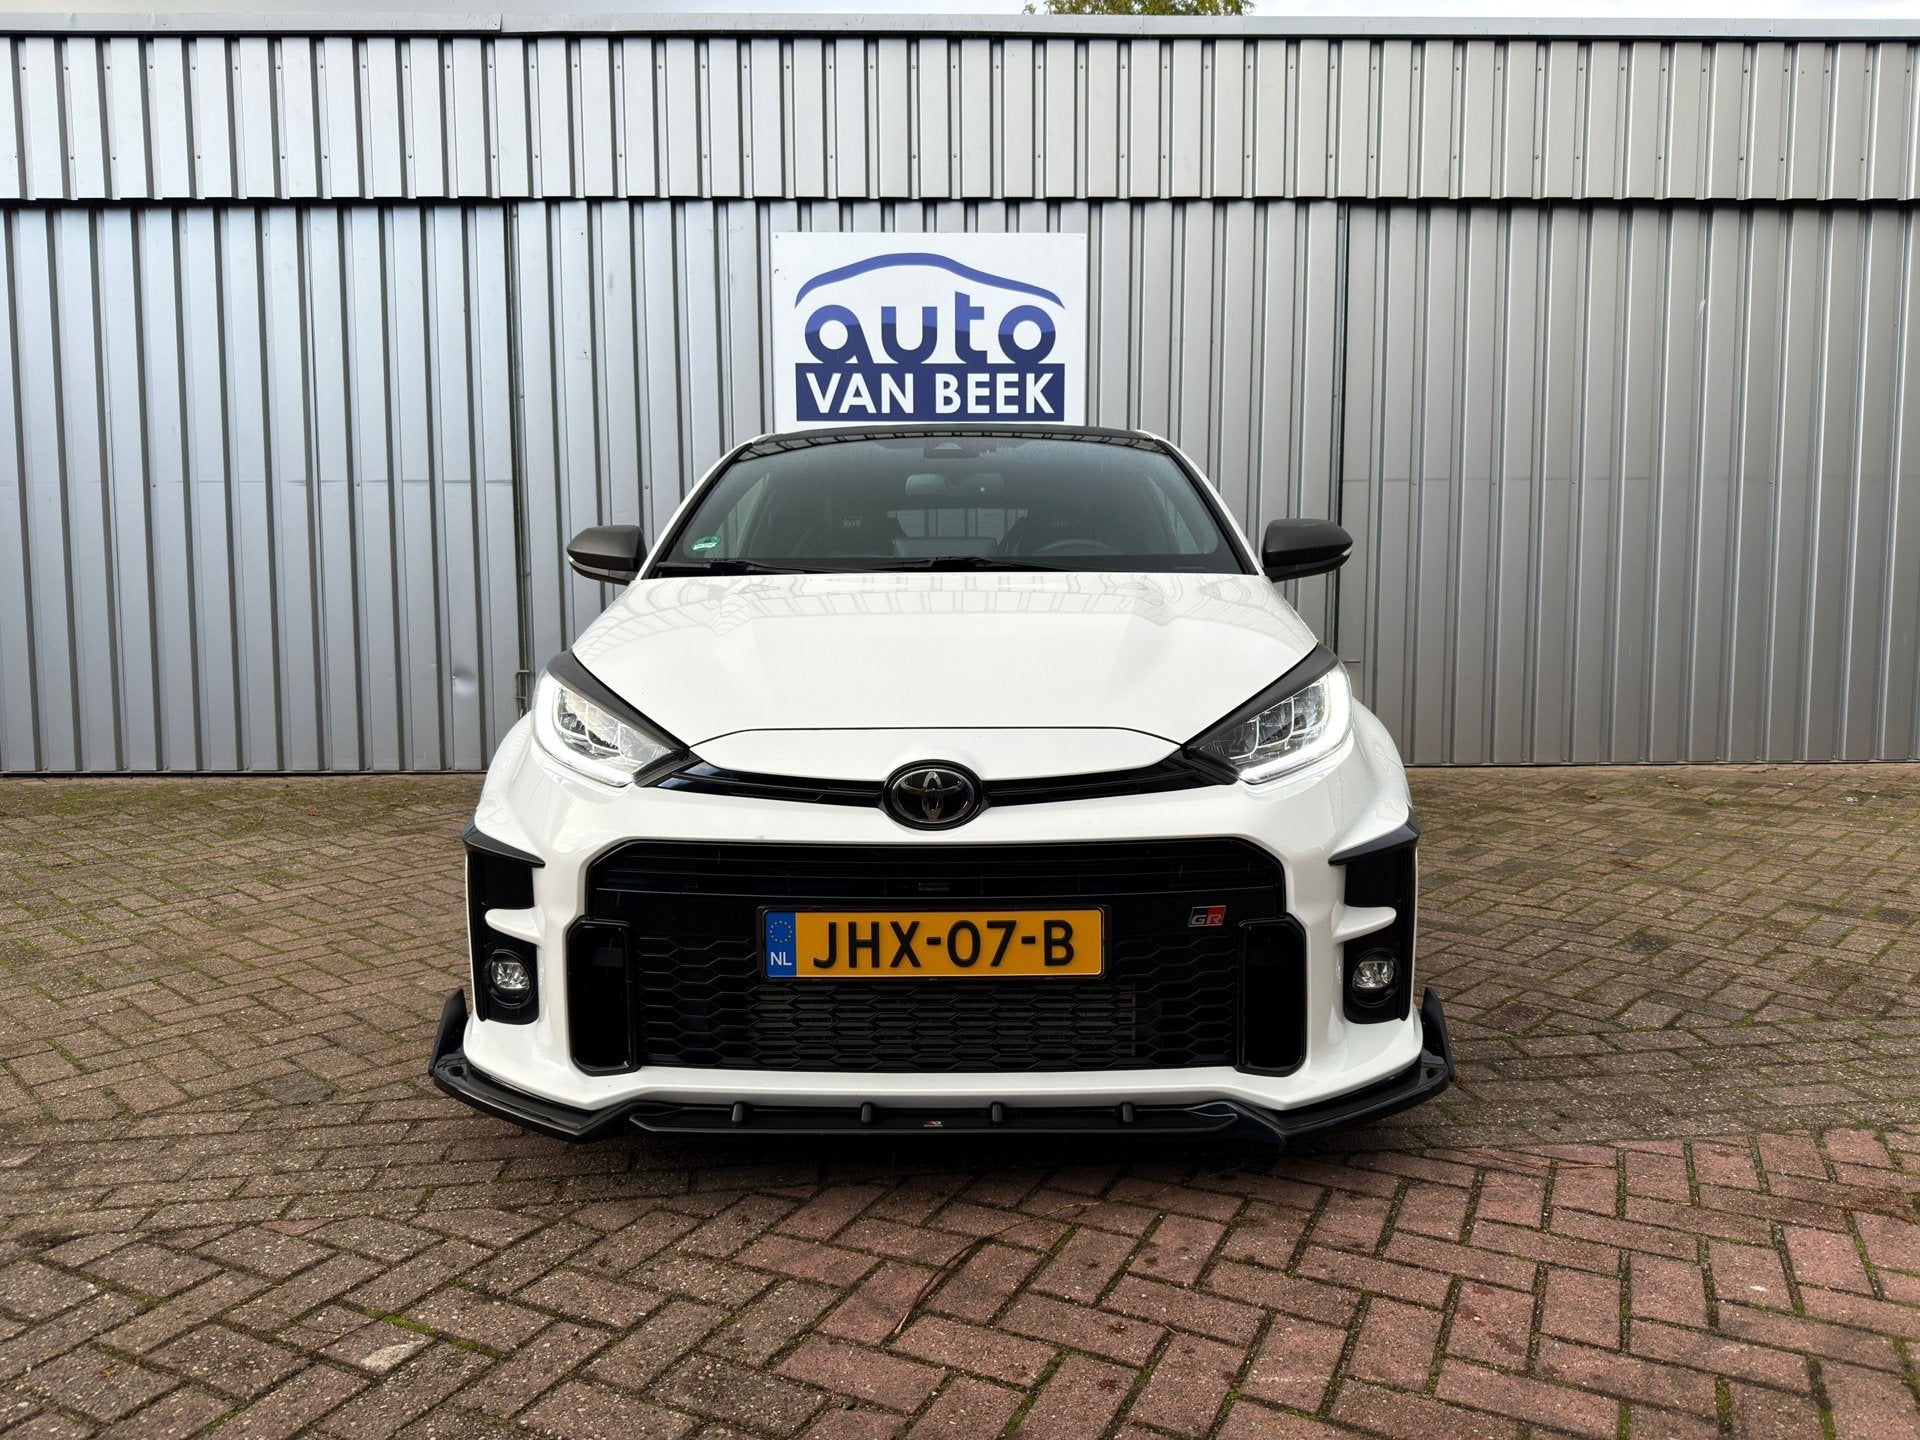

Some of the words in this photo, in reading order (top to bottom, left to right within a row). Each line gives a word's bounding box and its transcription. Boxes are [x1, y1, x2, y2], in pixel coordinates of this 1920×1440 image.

[804, 291, 1056, 364] auto
[805, 372, 915, 414] VAN
[935, 372, 1055, 414] BEEK
[1190, 914, 1223, 925] GR
[770, 951, 793, 966] NL
[813, 919, 1075, 969] JHX-07-B
